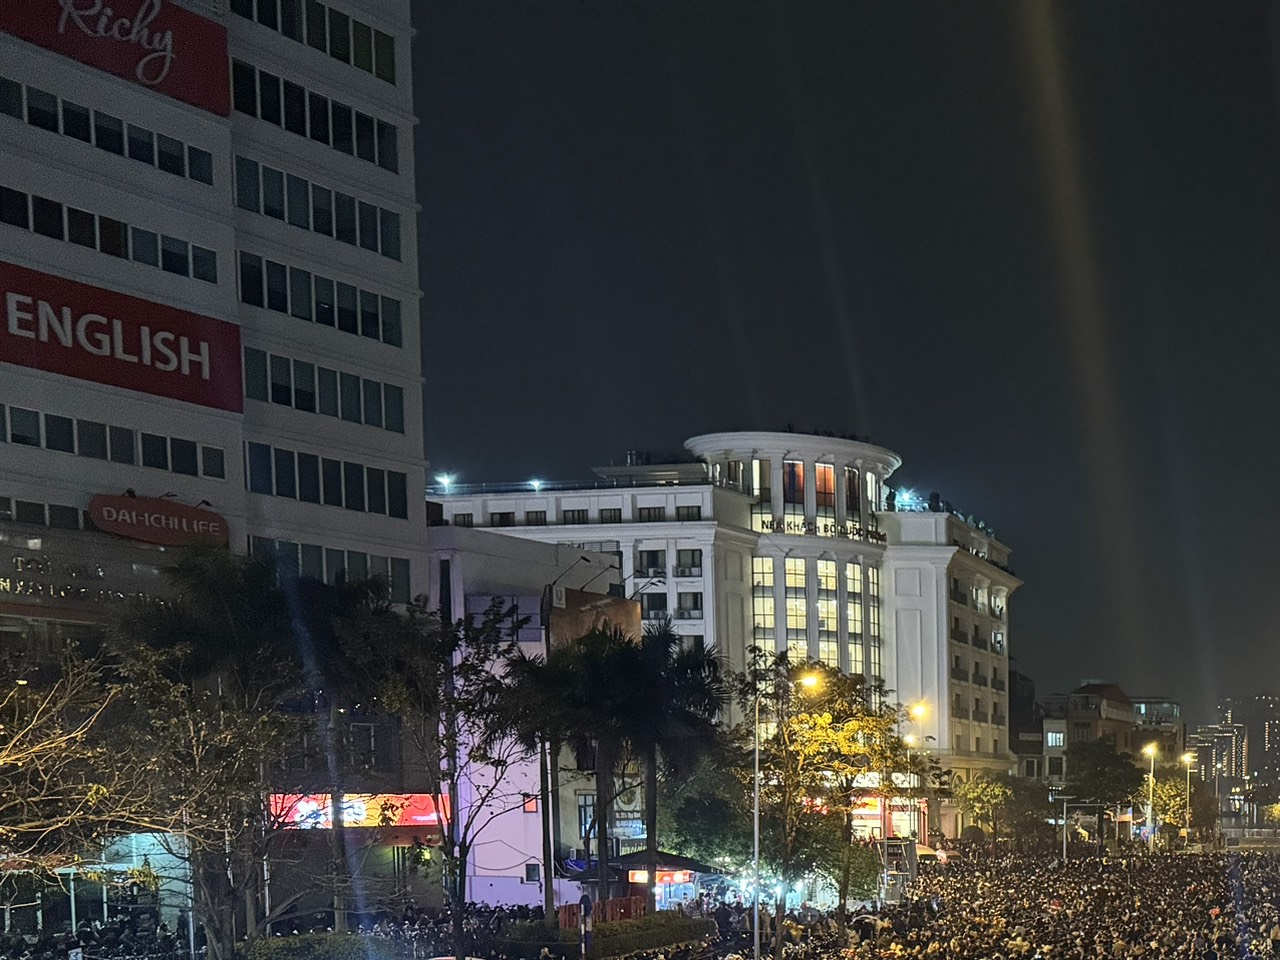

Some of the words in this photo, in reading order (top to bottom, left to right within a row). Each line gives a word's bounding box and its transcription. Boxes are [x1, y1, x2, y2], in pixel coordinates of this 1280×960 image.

[6, 293, 210, 380] ENGLISH
[102, 506, 178, 530] DAI-ICHI
[181, 518, 220, 535] LIFE
